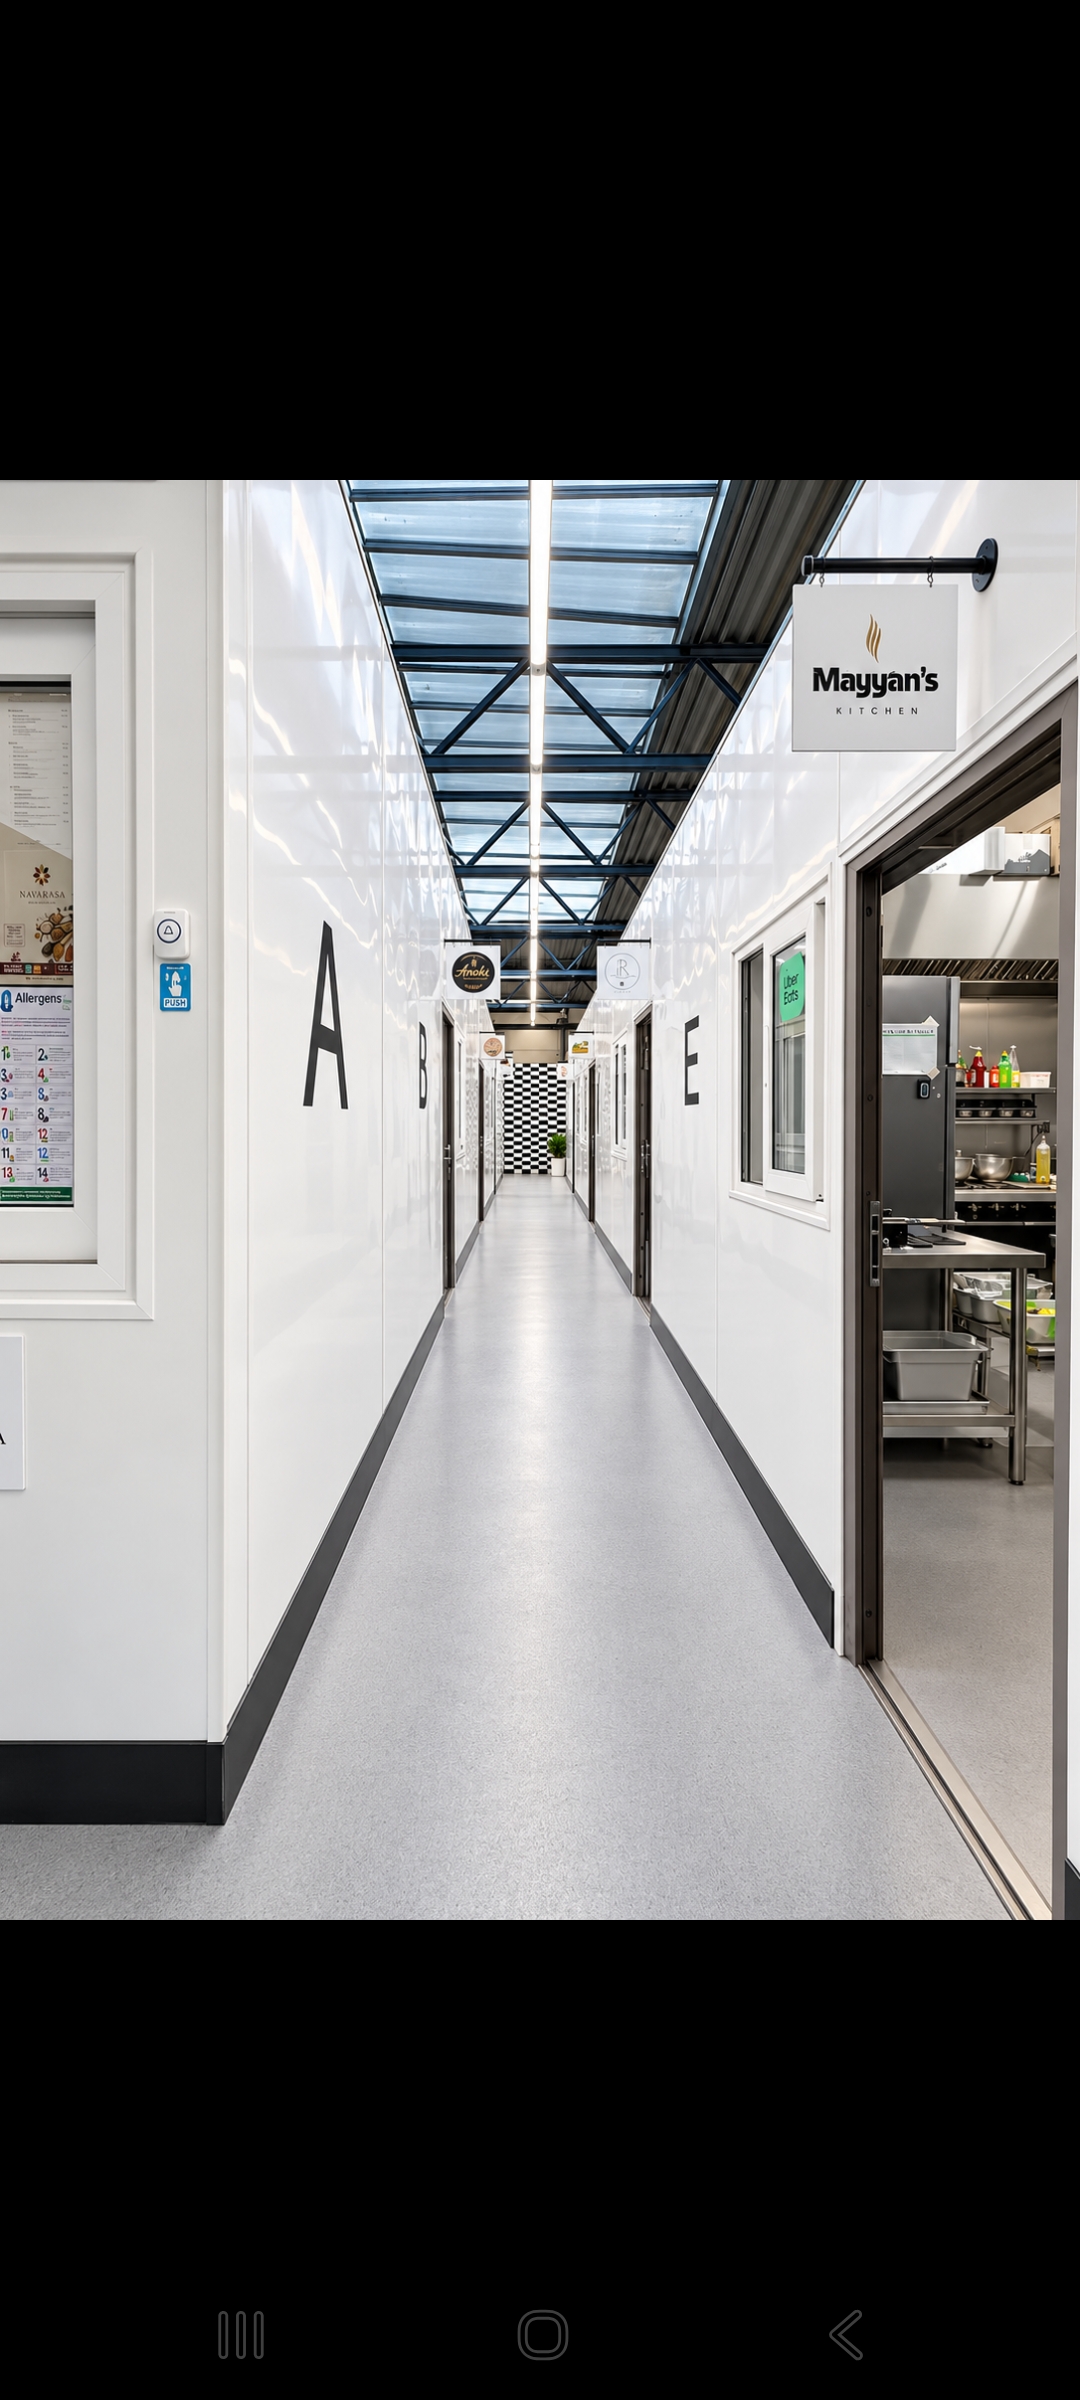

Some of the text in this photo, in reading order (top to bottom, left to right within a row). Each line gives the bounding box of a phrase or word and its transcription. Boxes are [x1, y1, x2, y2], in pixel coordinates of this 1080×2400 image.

[812, 666, 939, 699] Mayyan's
[836, 707, 918, 715] KITCHEN
[20, 891, 65, 899] NAVARASA
[15, 992, 62, 1006] Allergens
[164, 999, 186, 1007] PUSH
[783, 989, 799, 1006] Eats
[303, 921, 348, 1109] A
[37, 1048, 45, 1061] 2
[684, 1015, 699, 1106] E
[418, 1021, 428, 1109] B
[1, 1107, 8, 1121] 7
[37, 1147, 48, 1159] 12
[37, 1167, 48, 1178] 14
